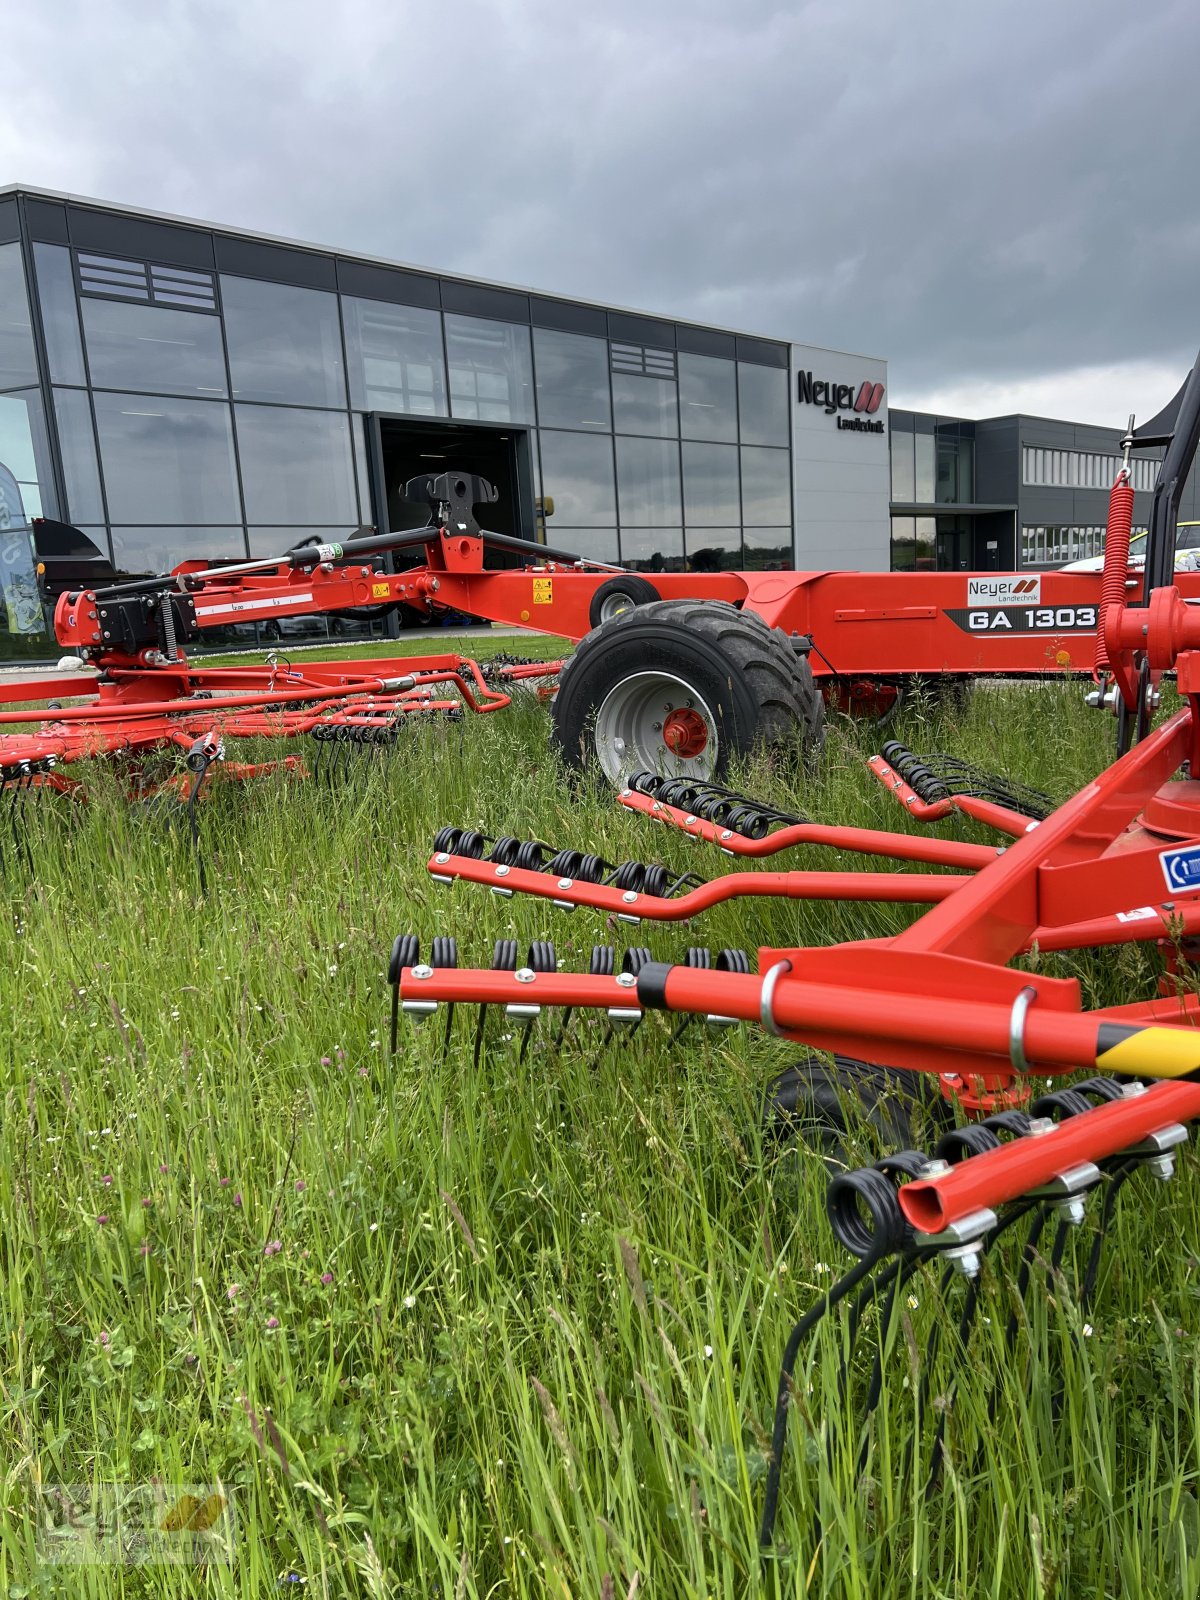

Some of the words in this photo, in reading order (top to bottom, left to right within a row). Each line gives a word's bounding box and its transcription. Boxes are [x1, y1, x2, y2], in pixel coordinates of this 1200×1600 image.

[798, 370, 855, 414] Neyer
[969, 582, 1012, 596] Neyer
[998, 594, 1038, 602] Landtechnik
[969, 611, 1012, 629] GA
[1025, 608, 1100, 628] 1303
